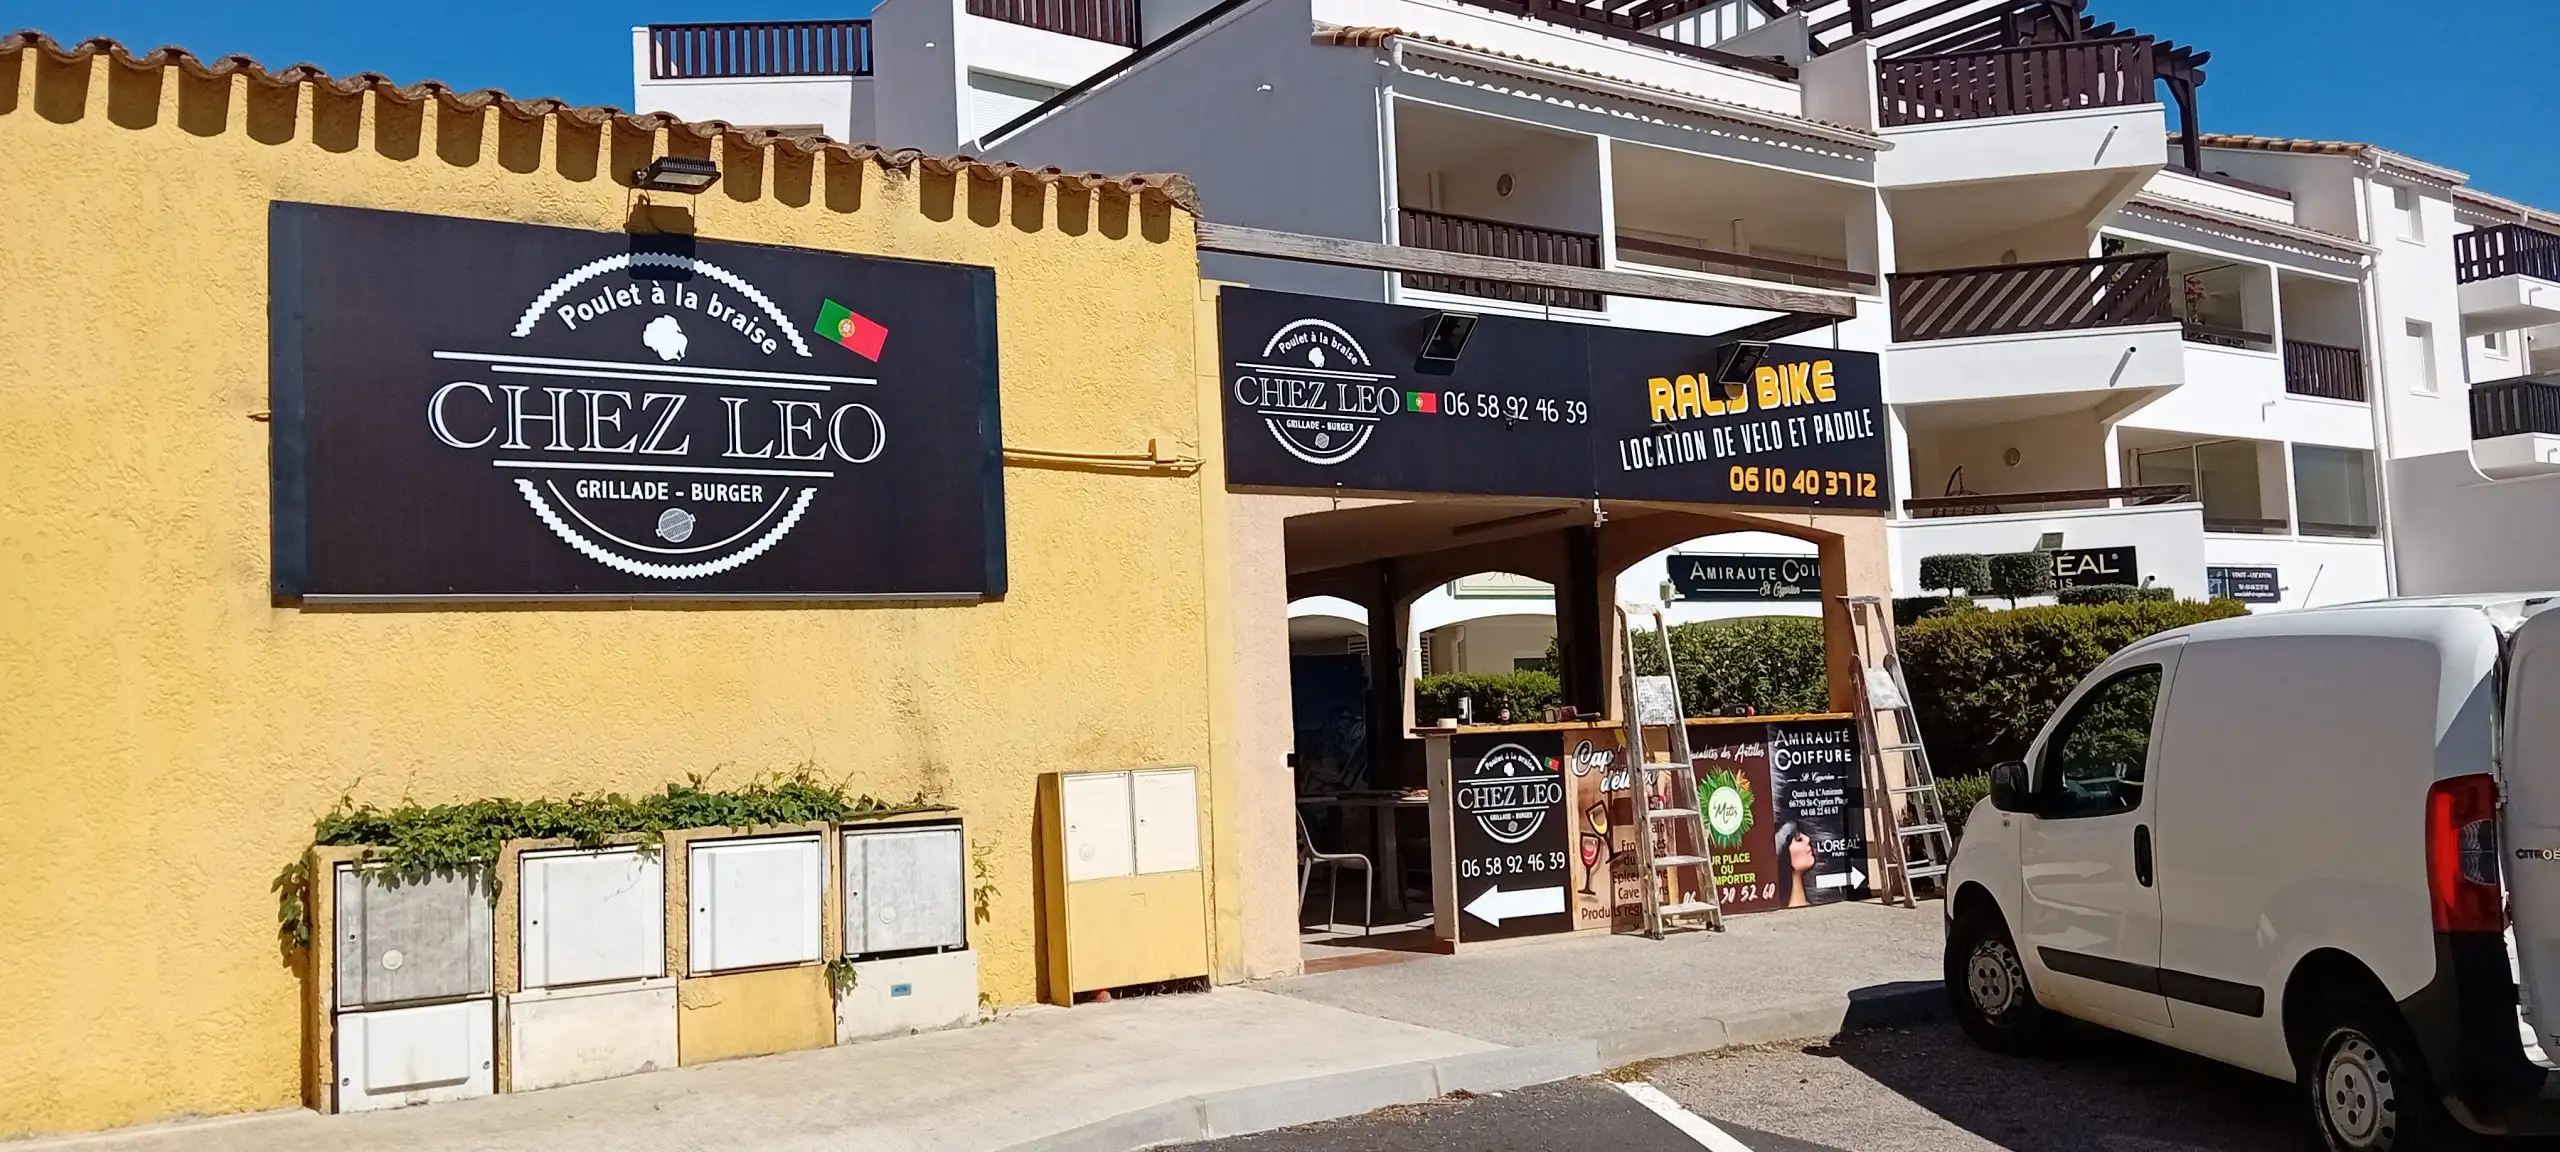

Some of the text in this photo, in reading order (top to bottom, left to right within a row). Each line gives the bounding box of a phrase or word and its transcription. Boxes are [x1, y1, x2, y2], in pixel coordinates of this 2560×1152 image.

[557, 280, 778, 355] Poulet à la braise
[1278, 331, 1358, 365] Poulet à la braise
[1234, 375, 1400, 415] CHEZ LEO
[1755, 359, 1837, 410] BIKE
[1443, 391, 1588, 424] 06 58 92 46 39
[427, 381, 888, 464] CHEZ LEO
[1286, 419, 1319, 430] GRILLADE
[1327, 421, 1354, 432] BURGER
[1619, 408, 1874, 471] LOCATION DE VELO ET PADDLE
[575, 479, 669, 501] GRILLADE
[691, 483, 763, 503] BURGER
[1729, 465, 1877, 497] 06 10 40 37 12
[1782, 559, 1820, 583] COI
[2049, 578, 2073, 589] RIS
[1774, 728, 1850, 747] AMIRAUTÉ
[1775, 748, 1852, 771] COIFFURE
[1457, 782, 1562, 809] CHEZ LEO
[1462, 851, 1565, 878] 06 58 92 46 39
[1711, 852, 1751, 866] UR PLACE
[1721, 864, 1734, 875] OU
[1714, 872, 1756, 886] MPORTER
[1618, 887, 1640, 899] Cave
[1721, 887, 1736, 904] 30
[1741, 884, 1758, 902] 52
[1763, 882, 1776, 900] 60
